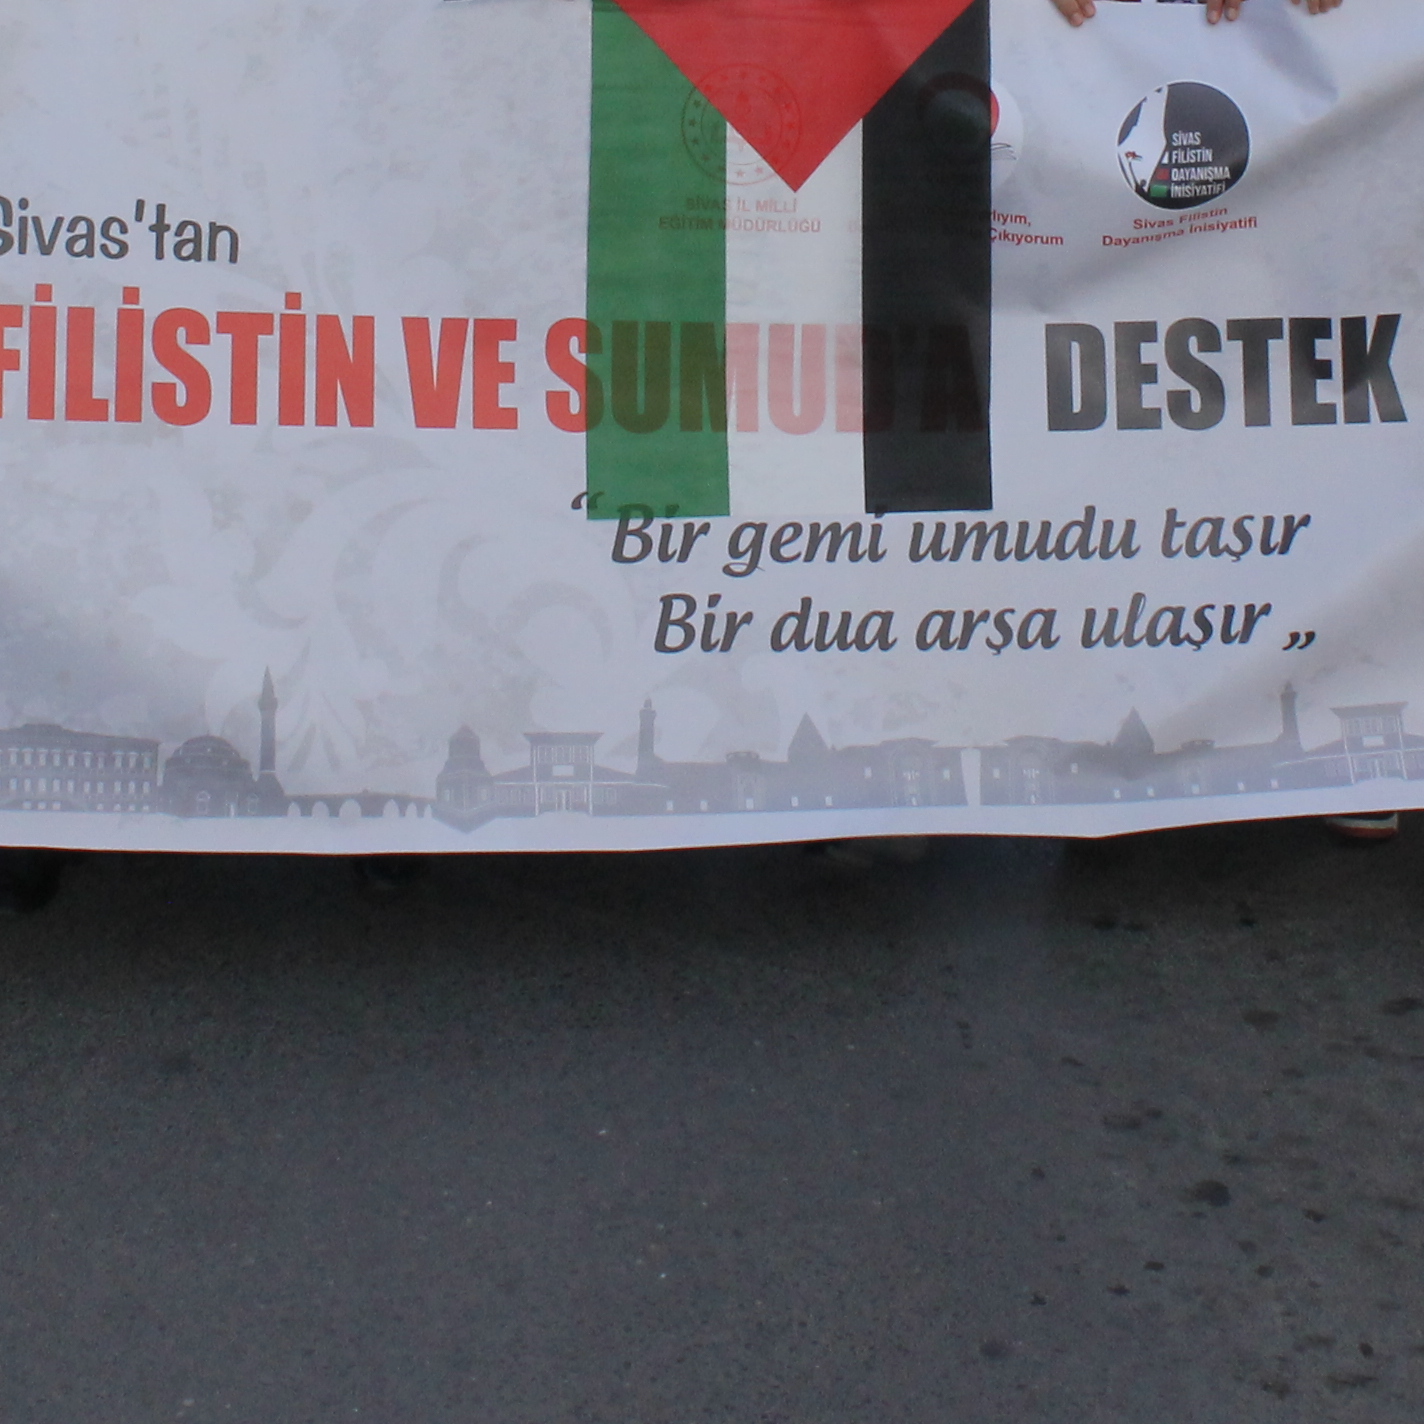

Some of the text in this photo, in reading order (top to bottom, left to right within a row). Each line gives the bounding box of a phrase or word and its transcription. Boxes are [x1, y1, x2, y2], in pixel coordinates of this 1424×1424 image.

[1171, 130, 1202, 147] SİVAS
[1171, 148, 1213, 164] FİLİSTİN
[1170, 165, 1232, 182] DAYANIŞMA
[990, 209, 1031, 227] lıyım,
[1133, 218, 1174, 230] Sivas
[1102, 229, 1185, 248] Dayanışma
[401, 316, 518, 430] VE
[1045, 312, 1408, 433] DESTEK
[722, 505, 890, 578] gemi
[907, 505, 1140, 564] umudu
[1159, 506, 1312, 564] taşır
[653, 592, 754, 654] Bir
[769, 596, 898, 653] dua
[914, 603, 1061, 657] arşa
